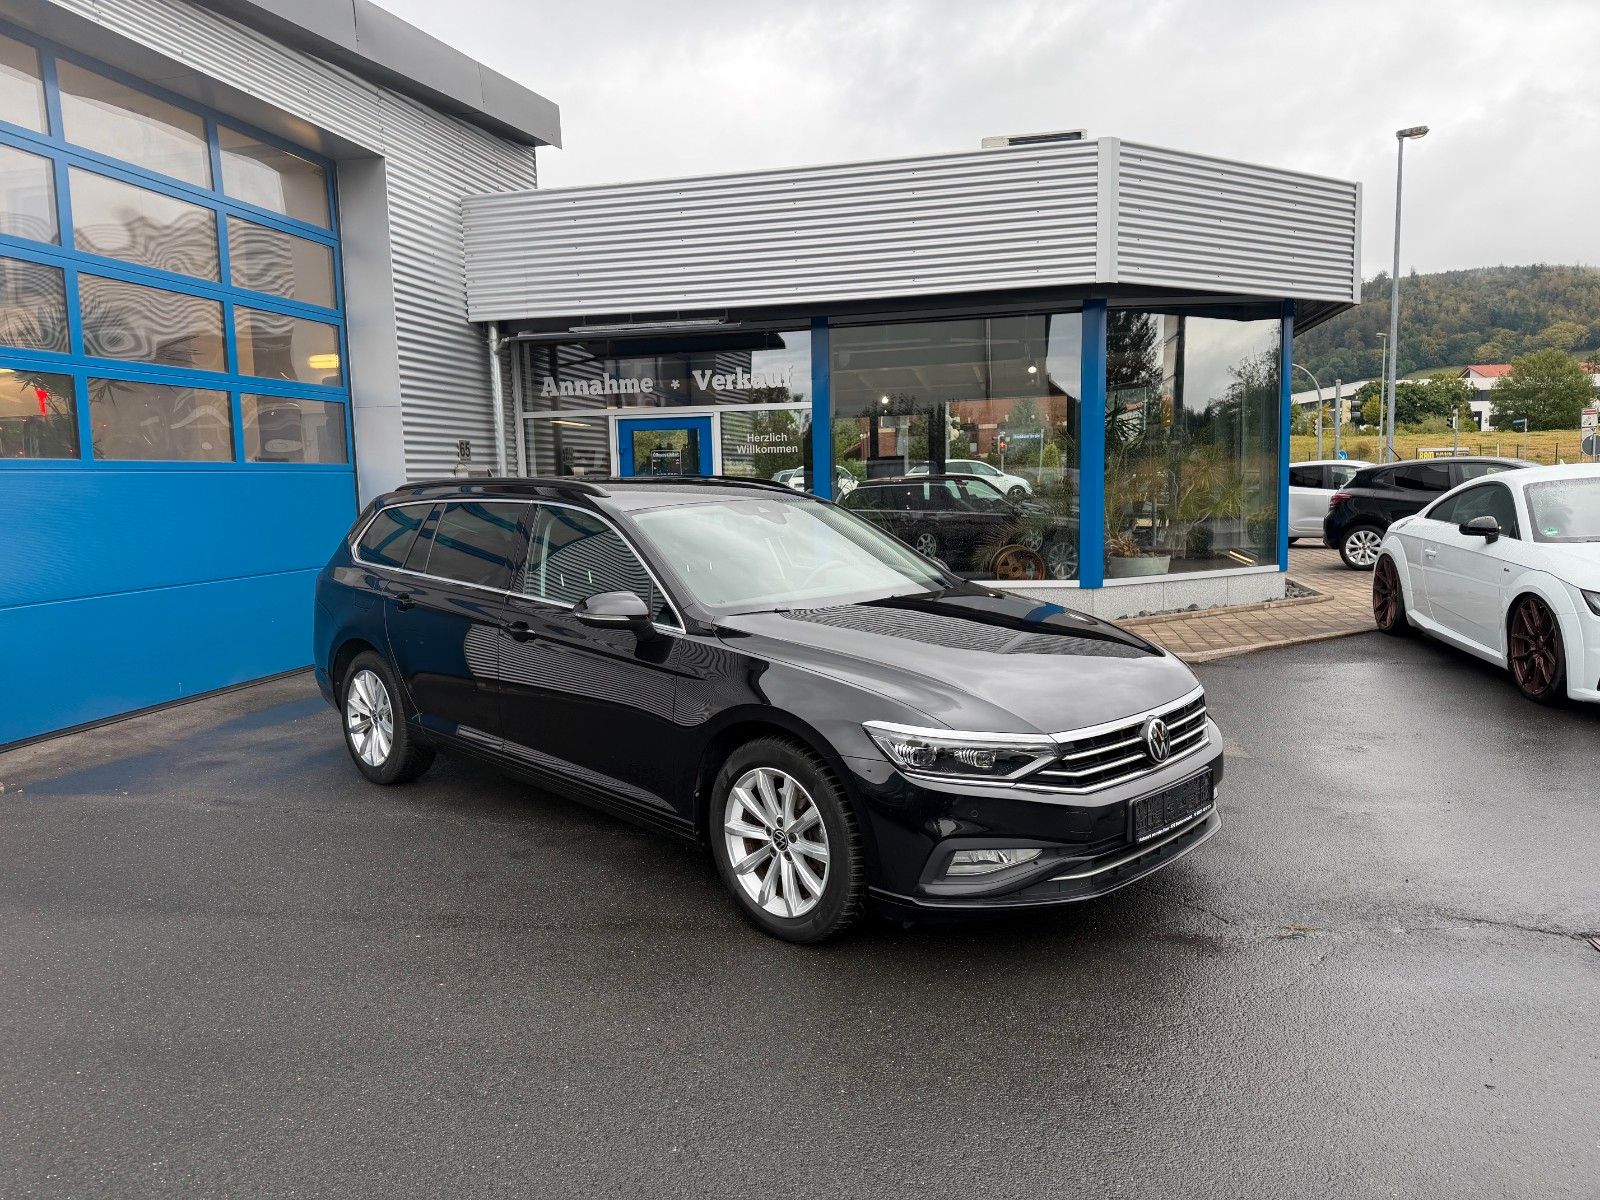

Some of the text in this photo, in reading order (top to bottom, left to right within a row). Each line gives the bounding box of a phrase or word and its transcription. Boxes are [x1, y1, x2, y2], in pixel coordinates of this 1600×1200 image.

[541, 365, 794, 397] Annahme Verkauf
[746, 432, 788, 443] Herzlich
[736, 444, 798, 454] Willkommen
